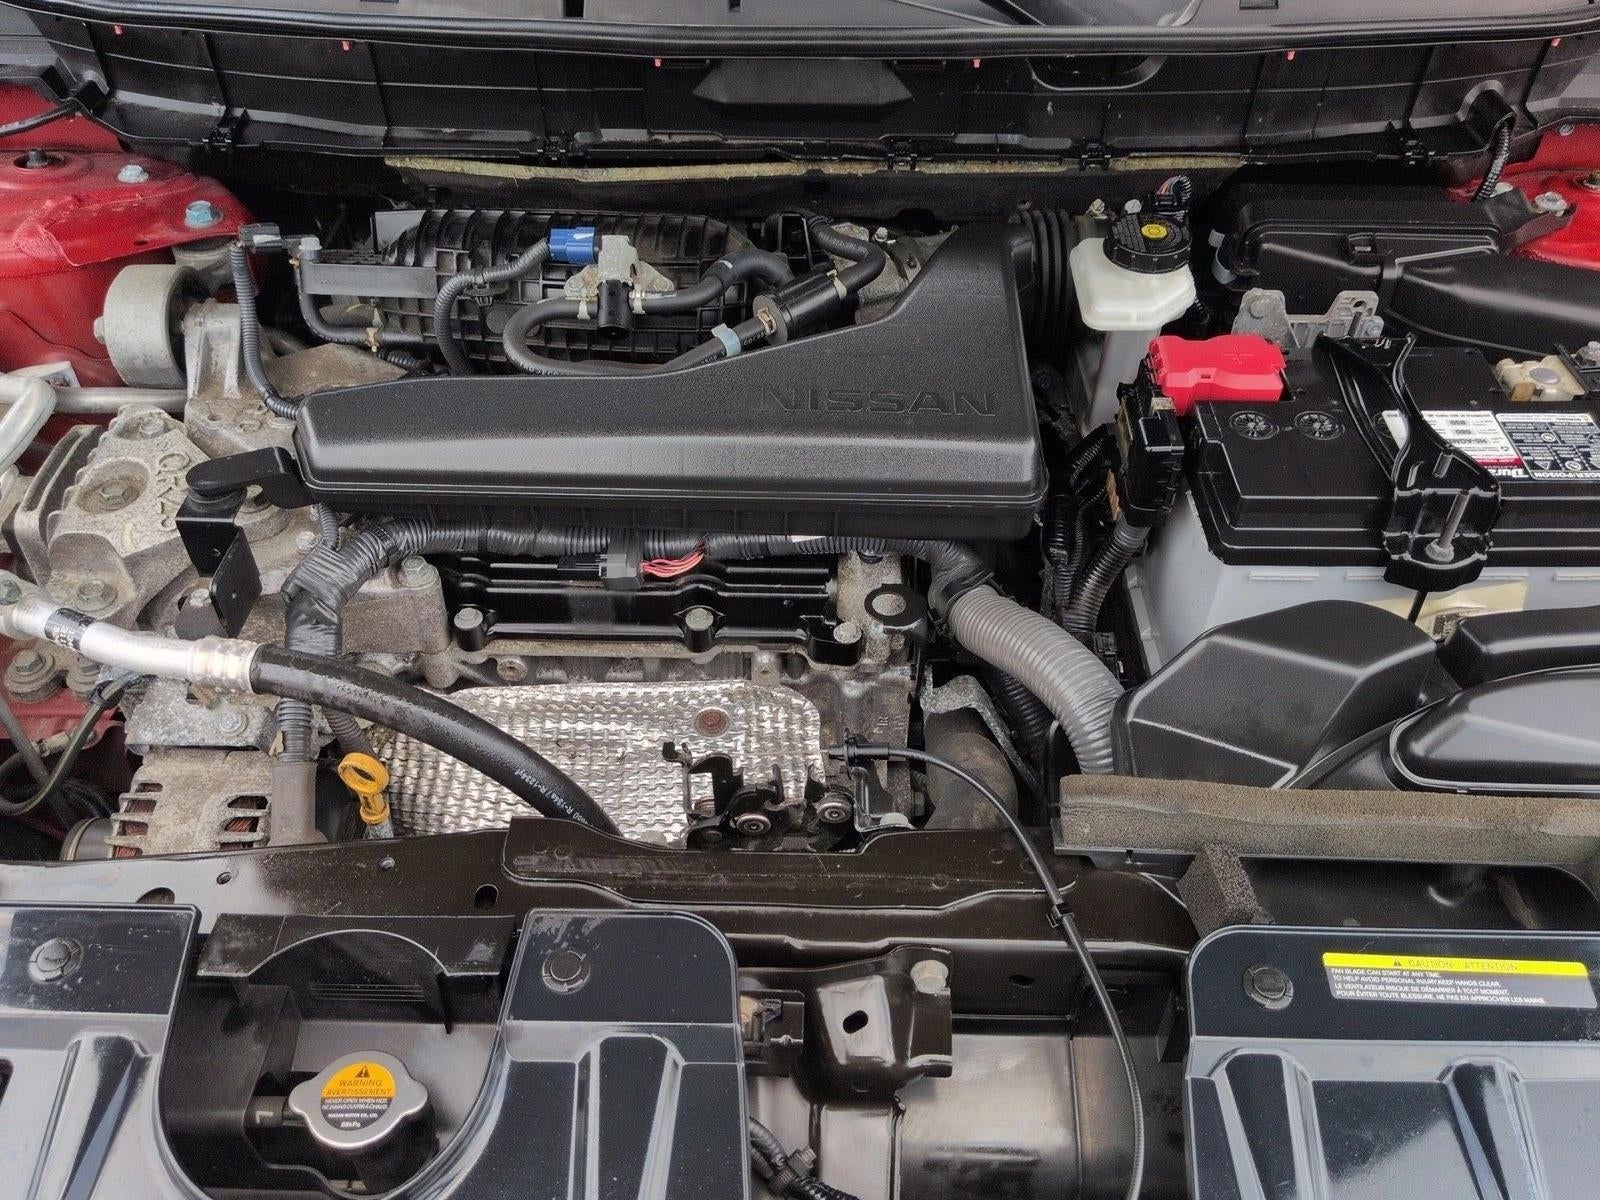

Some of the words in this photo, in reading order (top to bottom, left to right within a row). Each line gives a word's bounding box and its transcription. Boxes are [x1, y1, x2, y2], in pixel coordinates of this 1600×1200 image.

[761, 387, 996, 416] NISSAN
[1486, 468, 1529, 478] Dura
[1408, 959, 1453, 969] CAUTION
[1464, 961, 1518, 971] ATTENTION
[340, 1079, 383, 1087] WARNING
